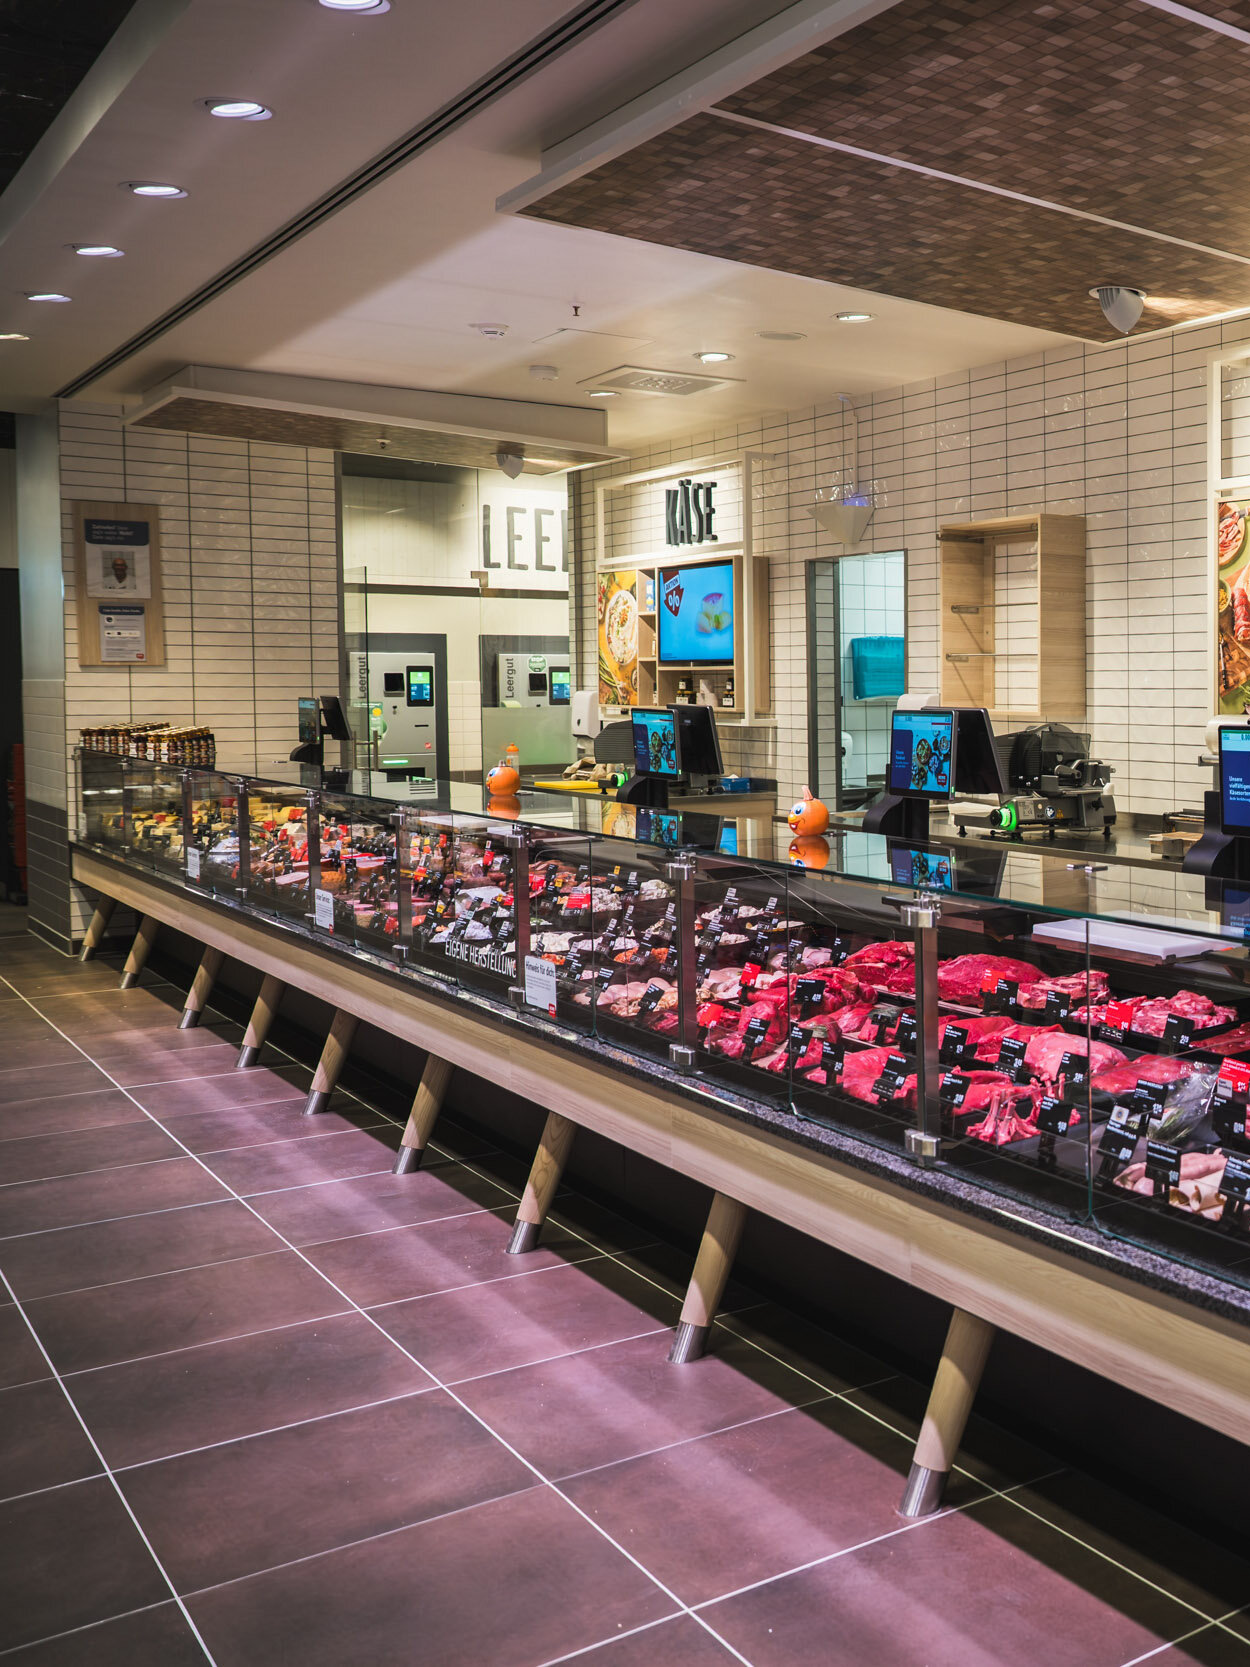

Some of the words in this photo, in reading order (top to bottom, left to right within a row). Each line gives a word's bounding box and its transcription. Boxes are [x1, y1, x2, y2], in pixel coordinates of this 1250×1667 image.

[665, 479, 718, 545] KÄSE
[665, 574, 680, 593] AKTION
[505, 657, 516, 698] Leergut
[445, 940, 468, 962] EIGENE
[526, 961, 540, 973] Hinweis
